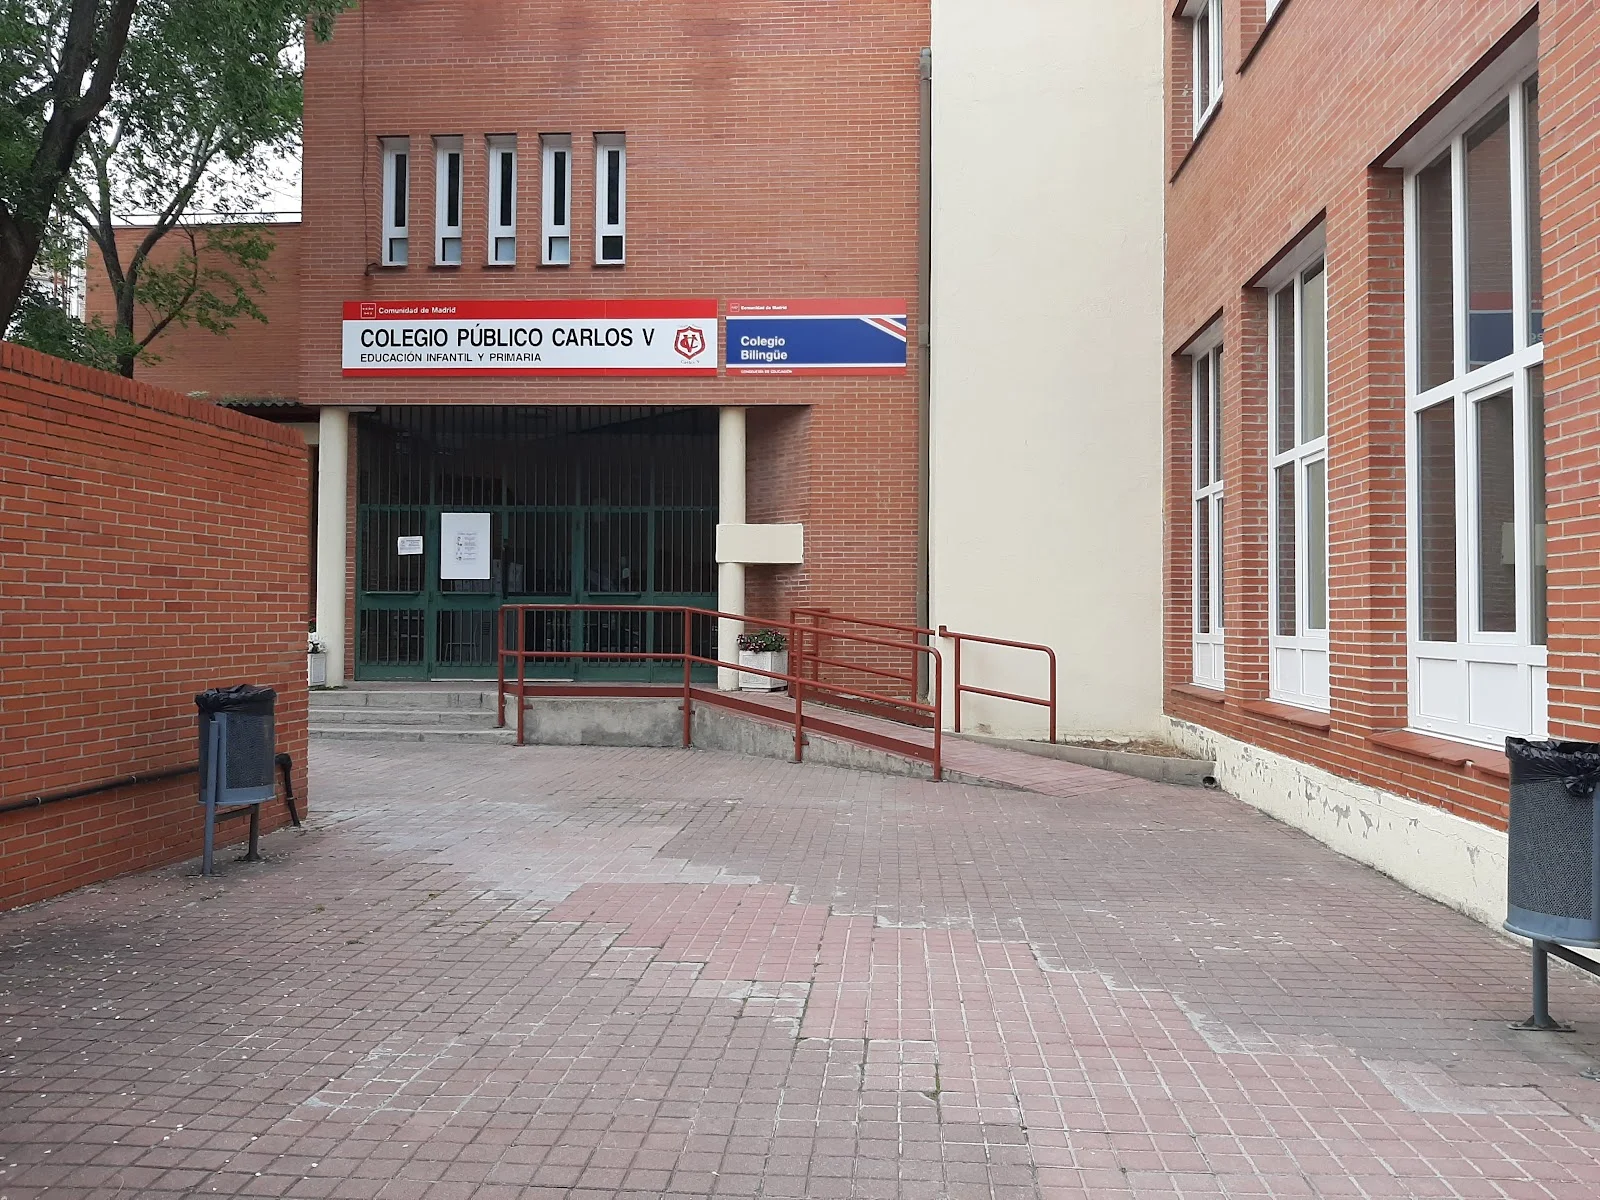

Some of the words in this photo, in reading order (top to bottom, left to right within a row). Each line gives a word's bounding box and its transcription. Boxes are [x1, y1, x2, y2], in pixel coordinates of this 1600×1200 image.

[361, 328, 448, 347] COLEGIO
[457, 323, 543, 347] PÚBLICO
[552, 327, 633, 347] CARLOS
[642, 327, 655, 347] V
[741, 336, 786, 348] Colegio
[361, 351, 422, 362] EDUCACIÓN
[426, 353, 473, 362] INFANTIL
[477, 353, 485, 362] Y
[489, 353, 542, 362] PRIMARIA
[741, 349, 788, 362] Bilingüe
